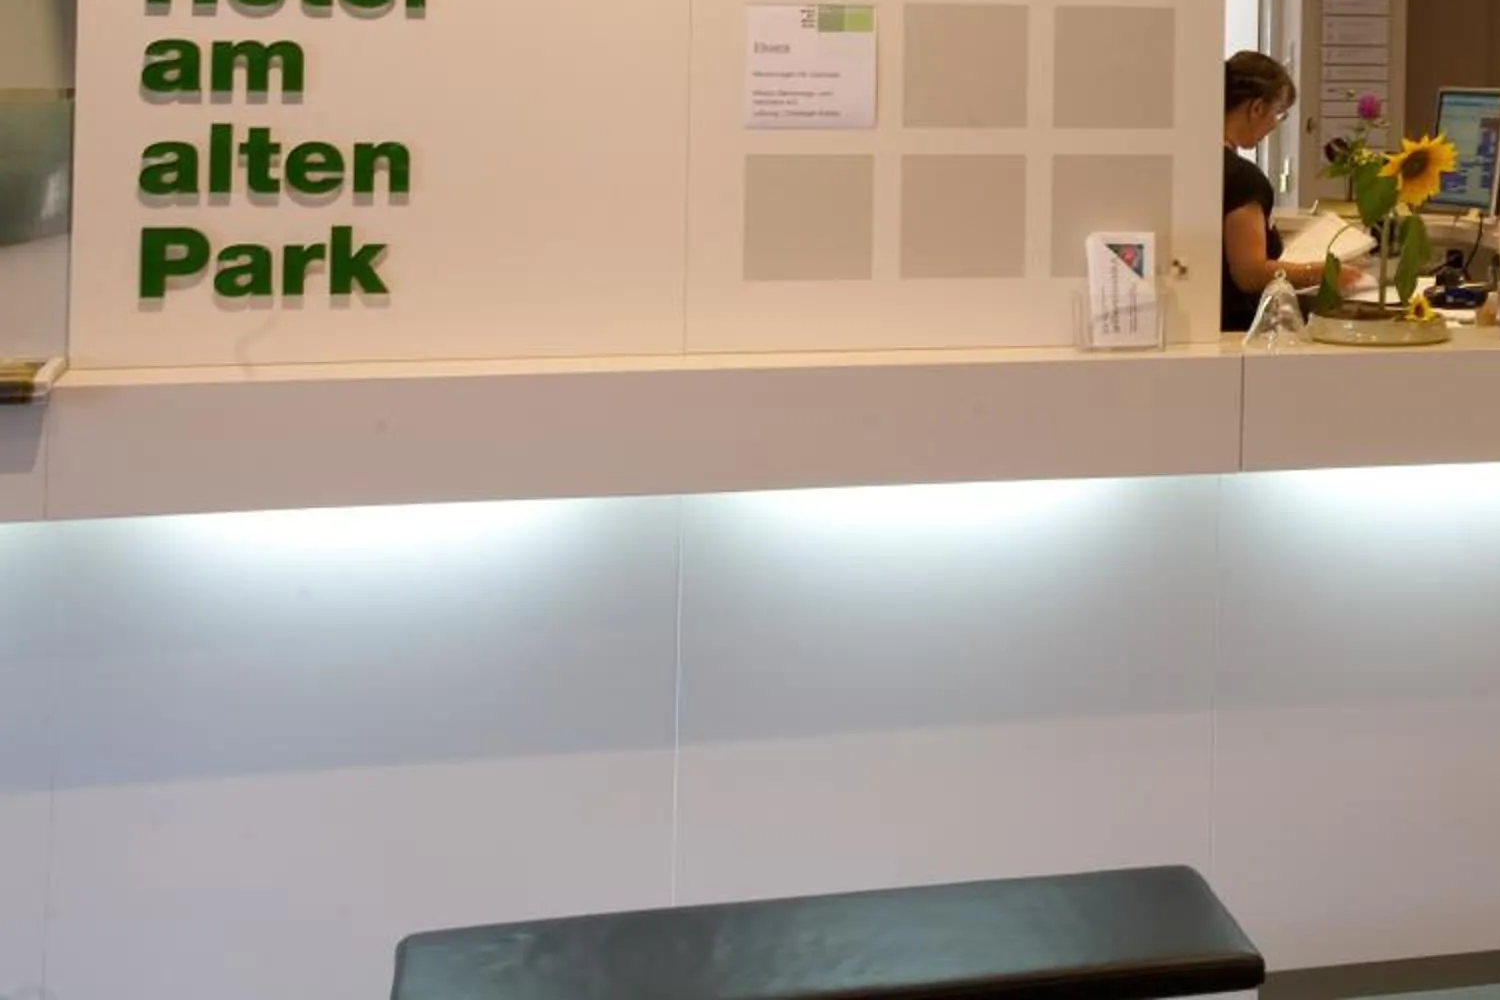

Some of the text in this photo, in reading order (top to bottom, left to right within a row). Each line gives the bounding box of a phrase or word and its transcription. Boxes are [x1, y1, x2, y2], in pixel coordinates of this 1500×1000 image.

[140, 37, 305, 92] am
[138, 123, 411, 196] alten
[138, 225, 390, 299] Park
